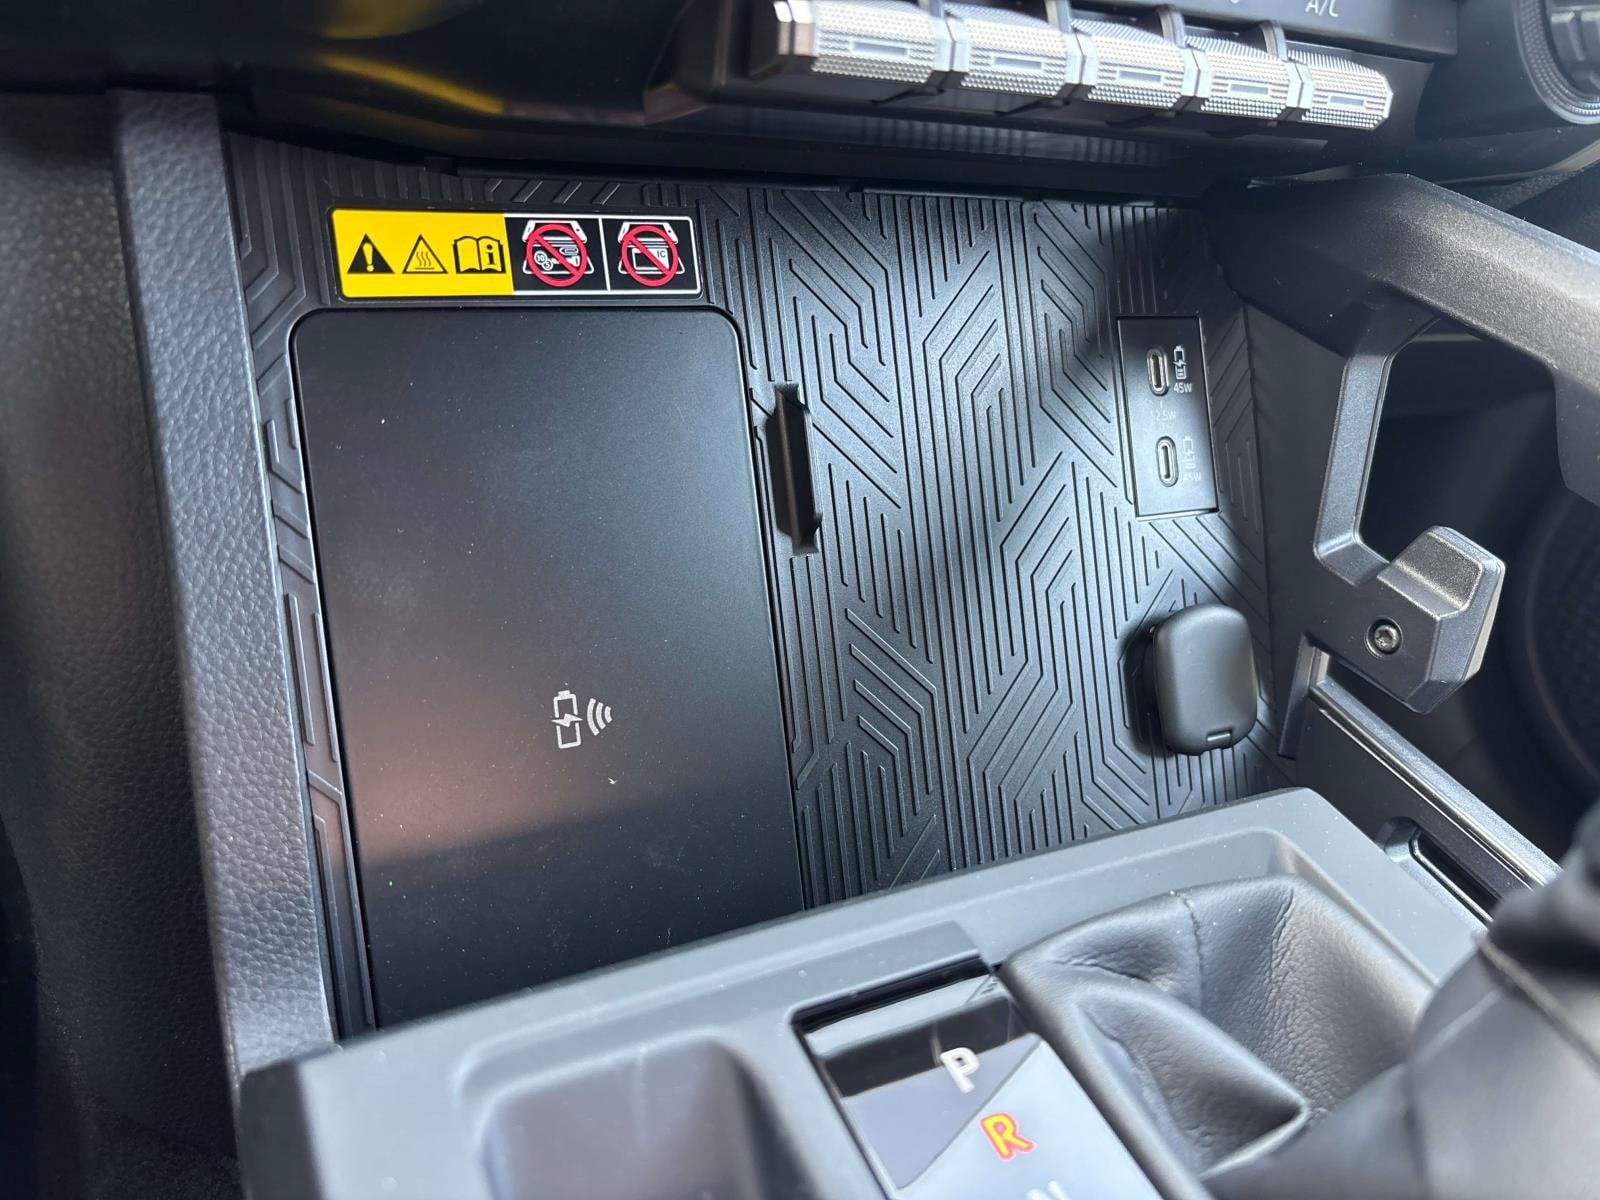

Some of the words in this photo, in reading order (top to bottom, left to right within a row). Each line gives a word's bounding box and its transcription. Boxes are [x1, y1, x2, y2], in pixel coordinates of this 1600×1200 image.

[1173, 382, 1192, 393] 45W
[940, 1047, 980, 1093] P
[980, 1112, 1036, 1161] R
